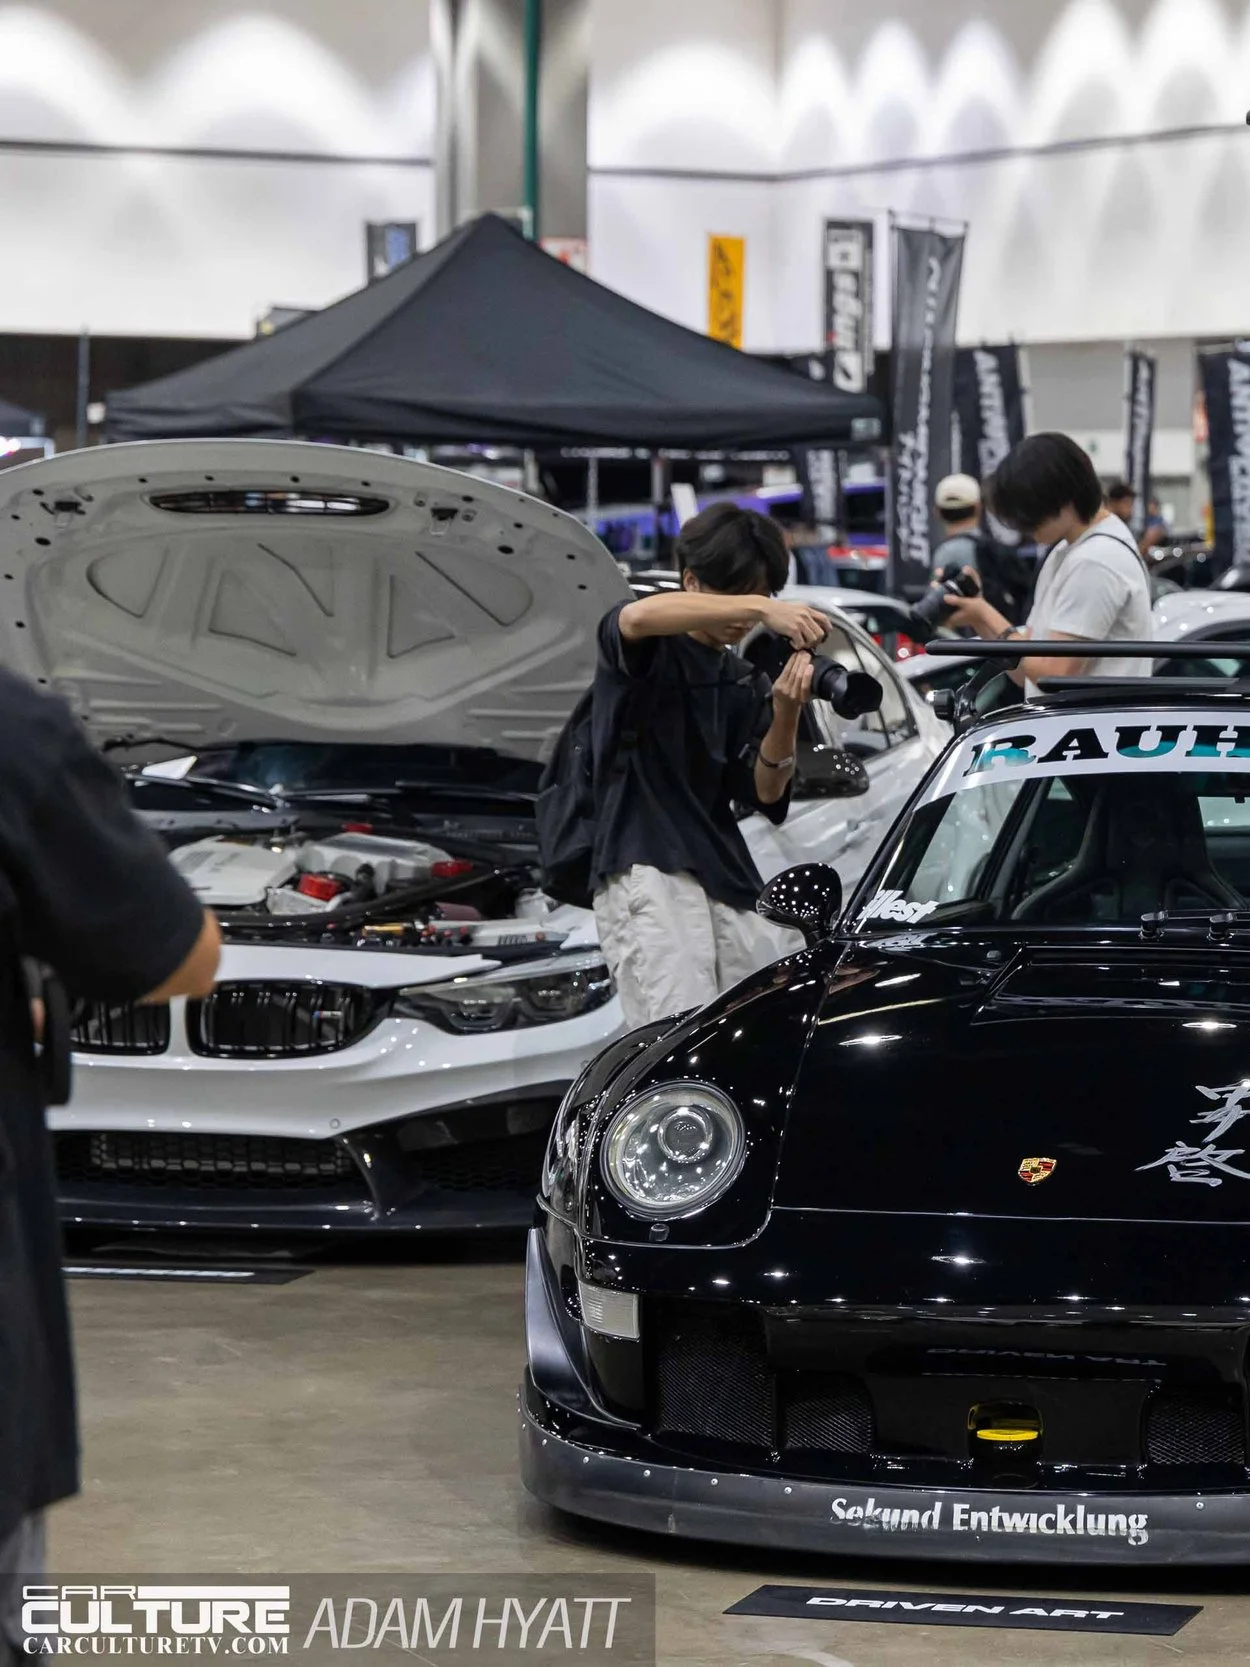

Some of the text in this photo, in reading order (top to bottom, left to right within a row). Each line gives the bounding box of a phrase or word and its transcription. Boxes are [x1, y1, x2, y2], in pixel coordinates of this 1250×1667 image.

[831, 1498, 1149, 1546] Sekund Entwicklung
[806, 1597, 1125, 1619] DRIVEN ART
